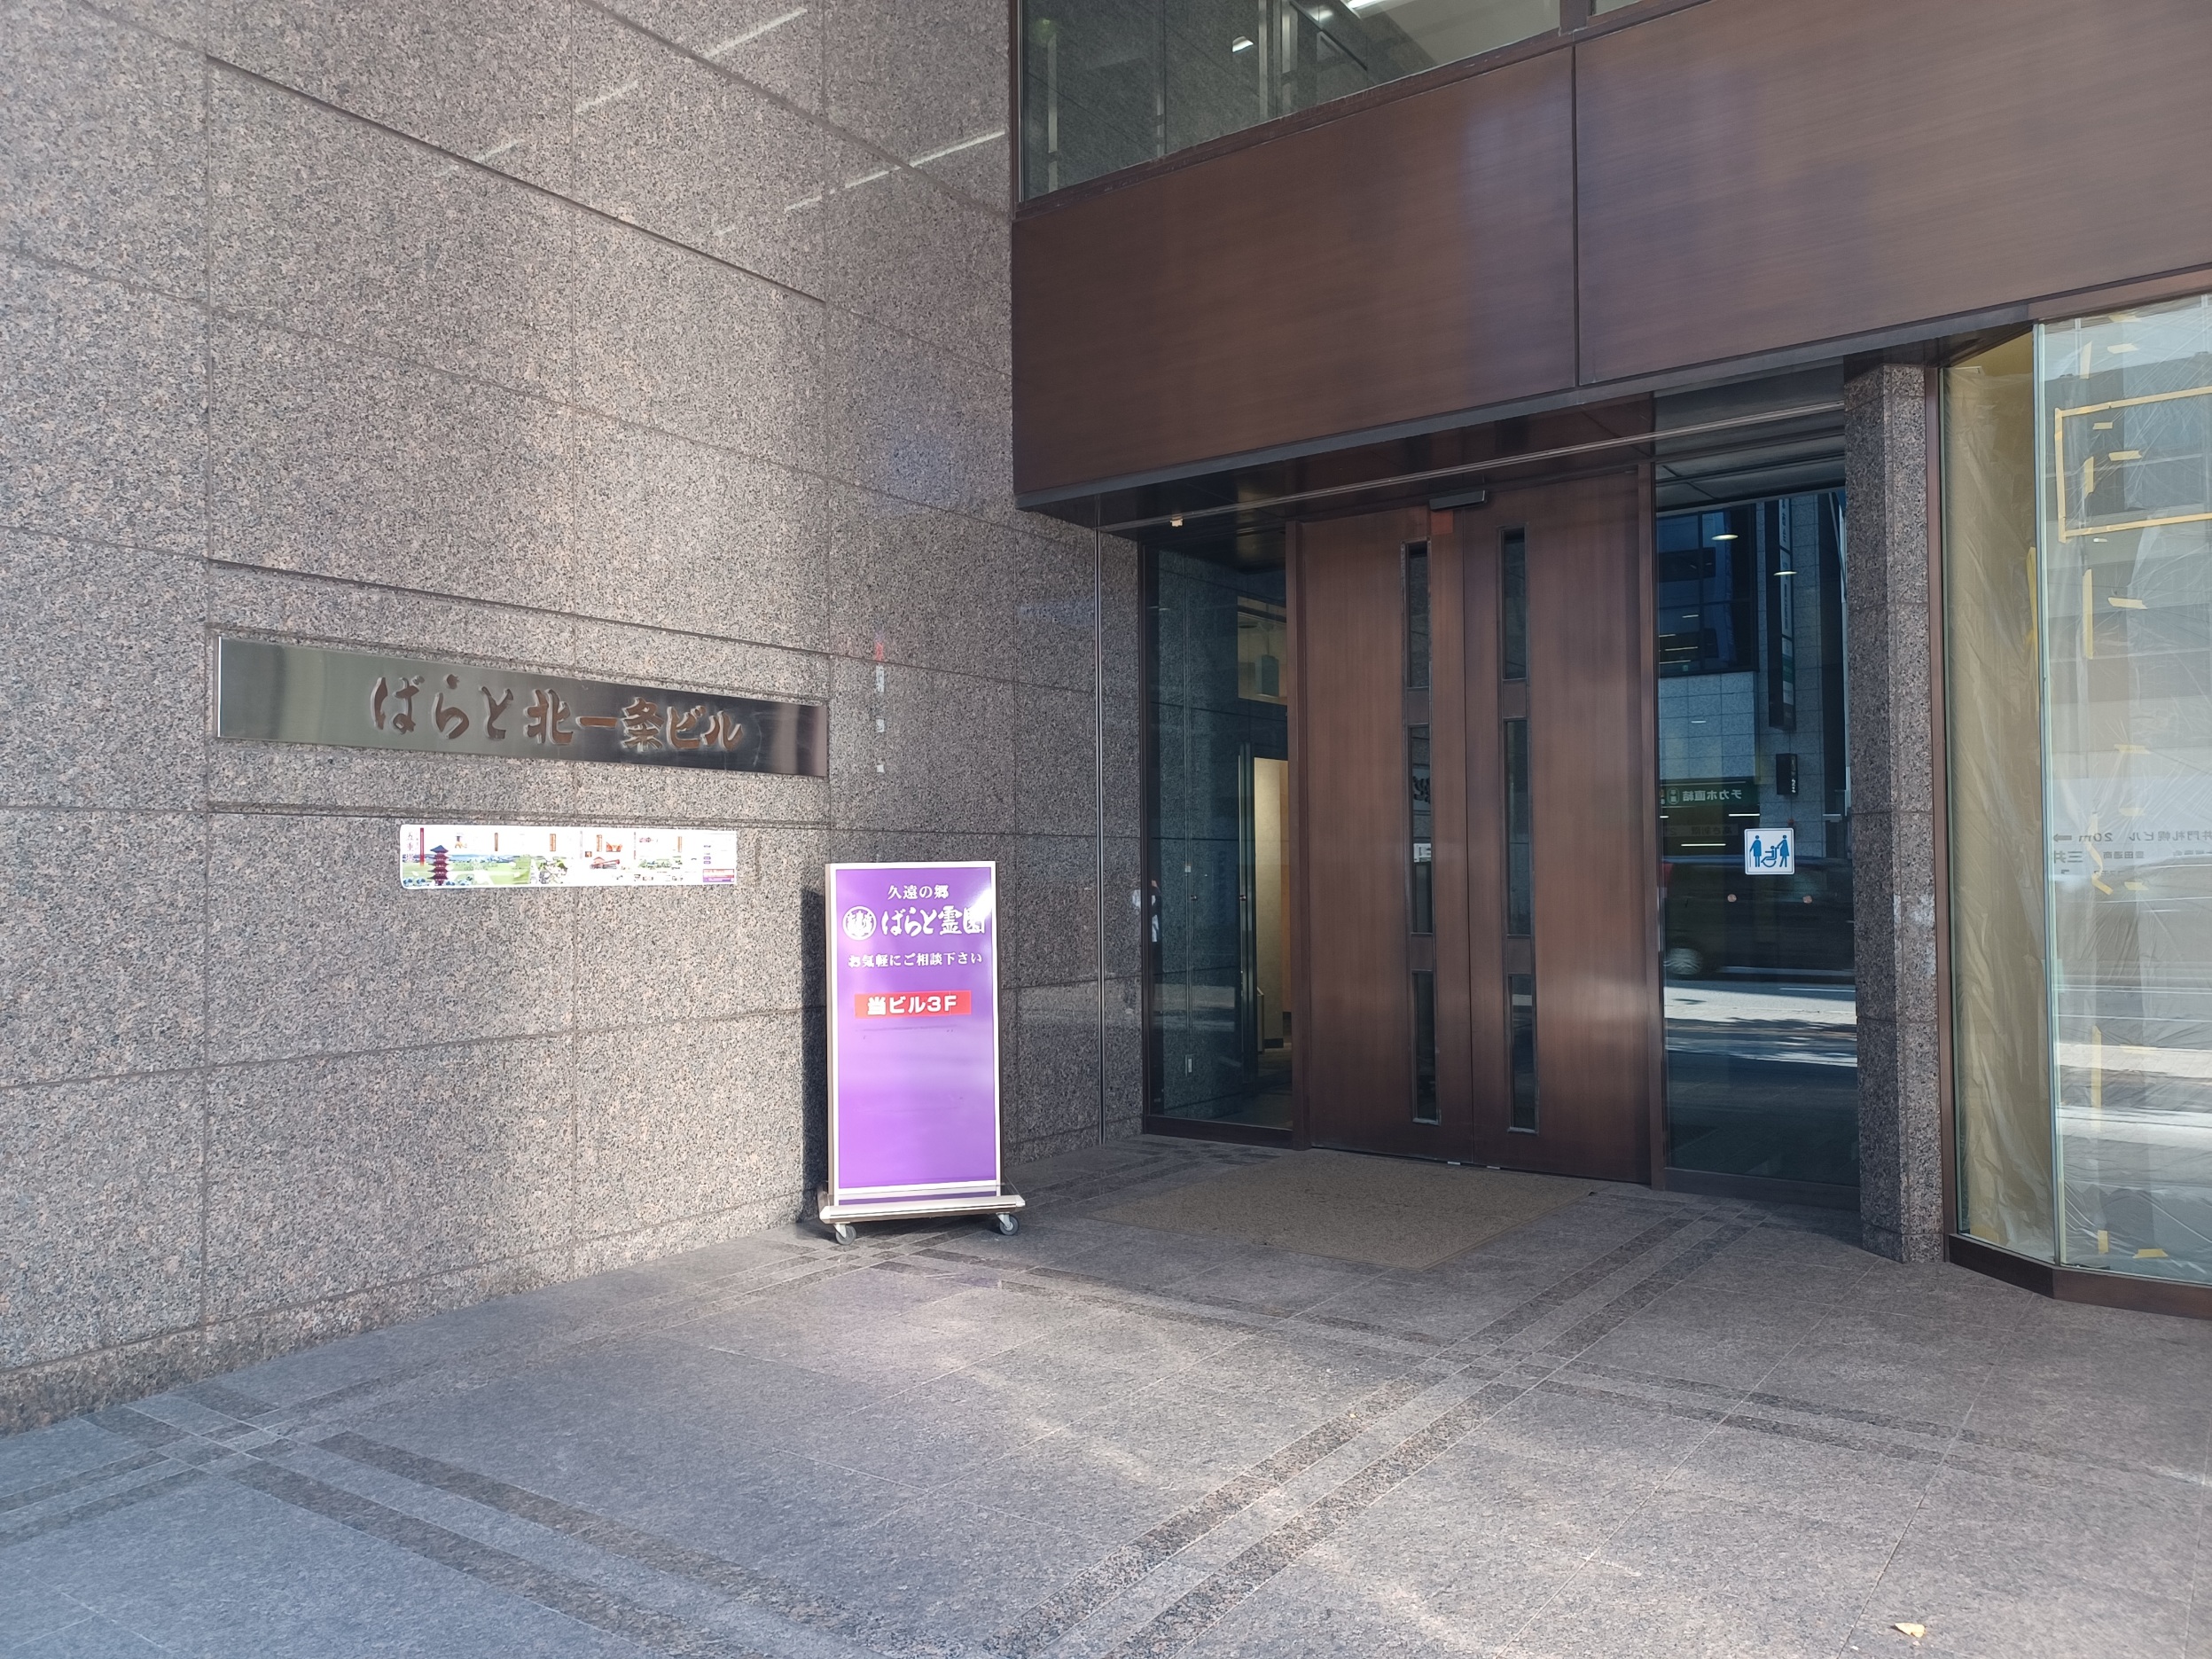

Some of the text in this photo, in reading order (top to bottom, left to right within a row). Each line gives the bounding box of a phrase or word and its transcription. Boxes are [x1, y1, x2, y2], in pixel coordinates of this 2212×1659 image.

[370, 675, 744, 751] ばらと北一条ビル
[887, 884, 950, 900] 久遠の郷
[881, 905, 986, 937] ばらと霊園
[848, 951, 982, 968] お気軽にご相談下さい
[867, 995, 957, 1016] 当ビル3F
